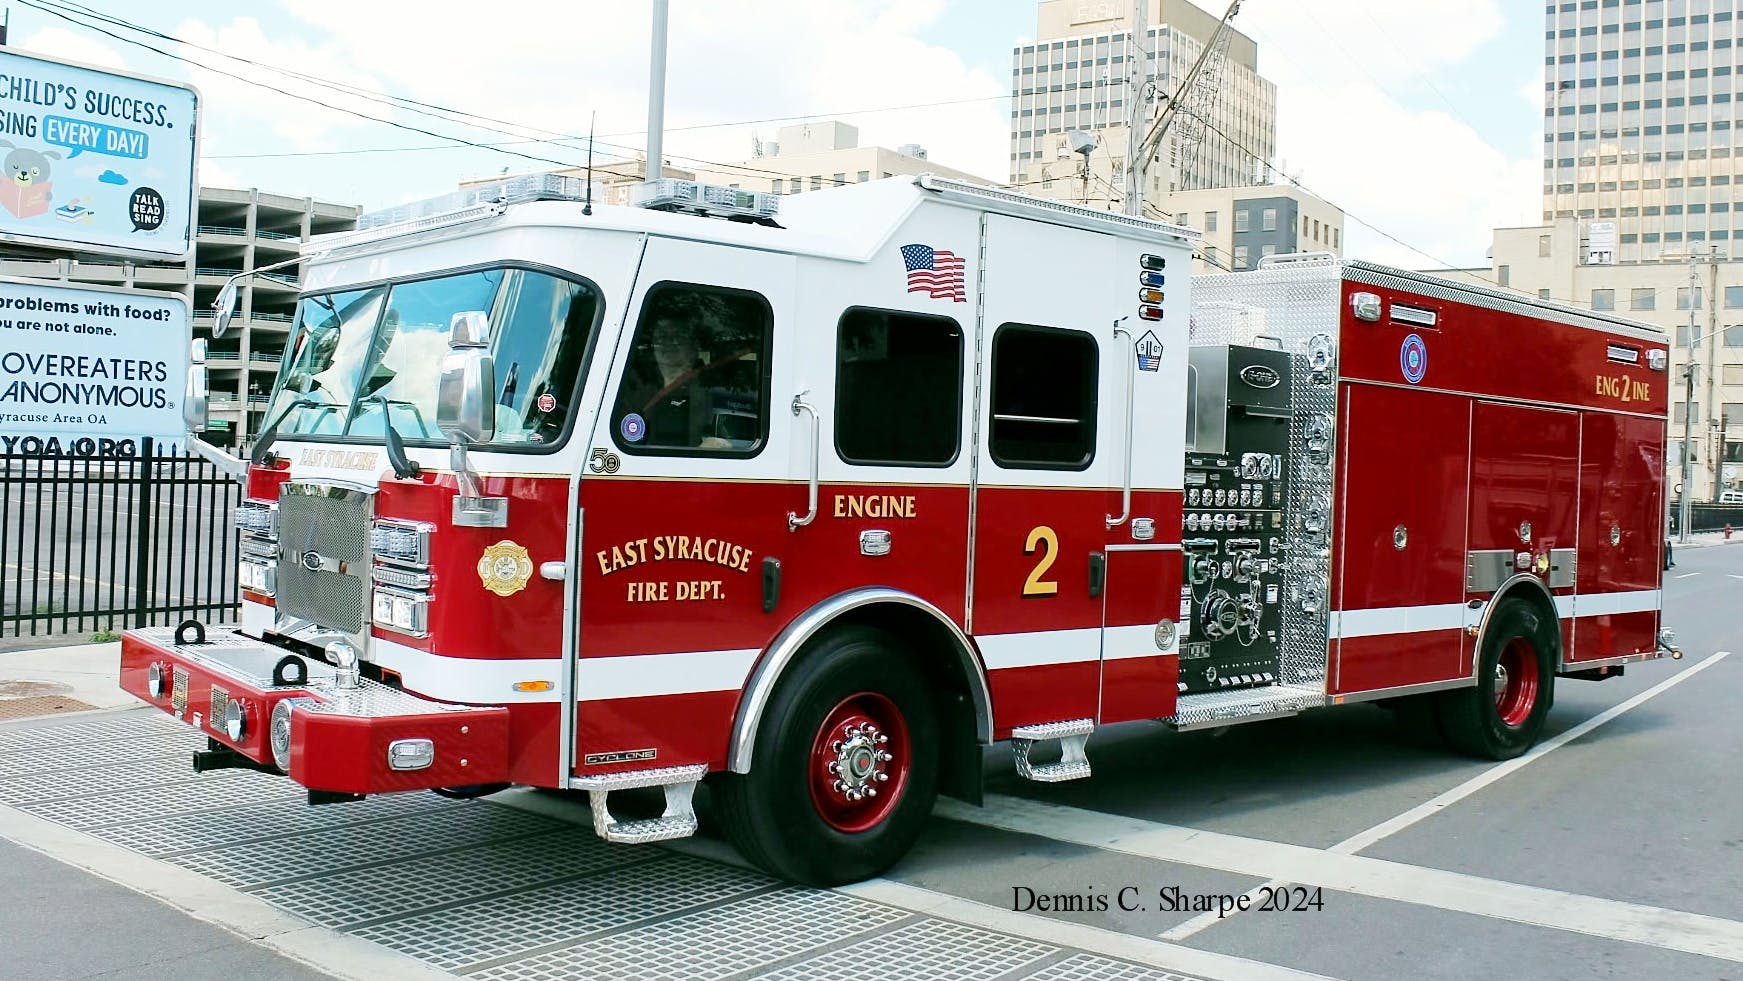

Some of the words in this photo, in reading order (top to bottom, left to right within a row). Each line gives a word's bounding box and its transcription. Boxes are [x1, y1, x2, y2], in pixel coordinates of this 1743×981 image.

[84, 89, 173, 129] SUCCESS.
[47, 119, 102, 148] EVERY
[107, 129, 144, 157] DAY!
[133, 203, 160, 215] READ
[135, 194, 159, 206] TALK
[134, 213, 159, 224] SING
[84, 301, 120, 317] with
[124, 304, 171, 321] food?
[16, 320, 41, 331] are
[45, 322, 70, 333] not
[73, 323, 117, 336] alone.
[1, 352, 167, 382] OVEREATERS
[53, 413, 83, 423] Area
[88, 414, 107, 424] OA
[833, 494, 917, 518] ENGINE
[596, 538, 648, 576] EAST
[653, 535, 753, 573] SYRACUSE
[1023, 525, 1059, 596] 2
[627, 581, 669, 602] FIRE
[675, 580, 726, 601] DEPT.
[587, 750, 655, 763] CYCLONE
